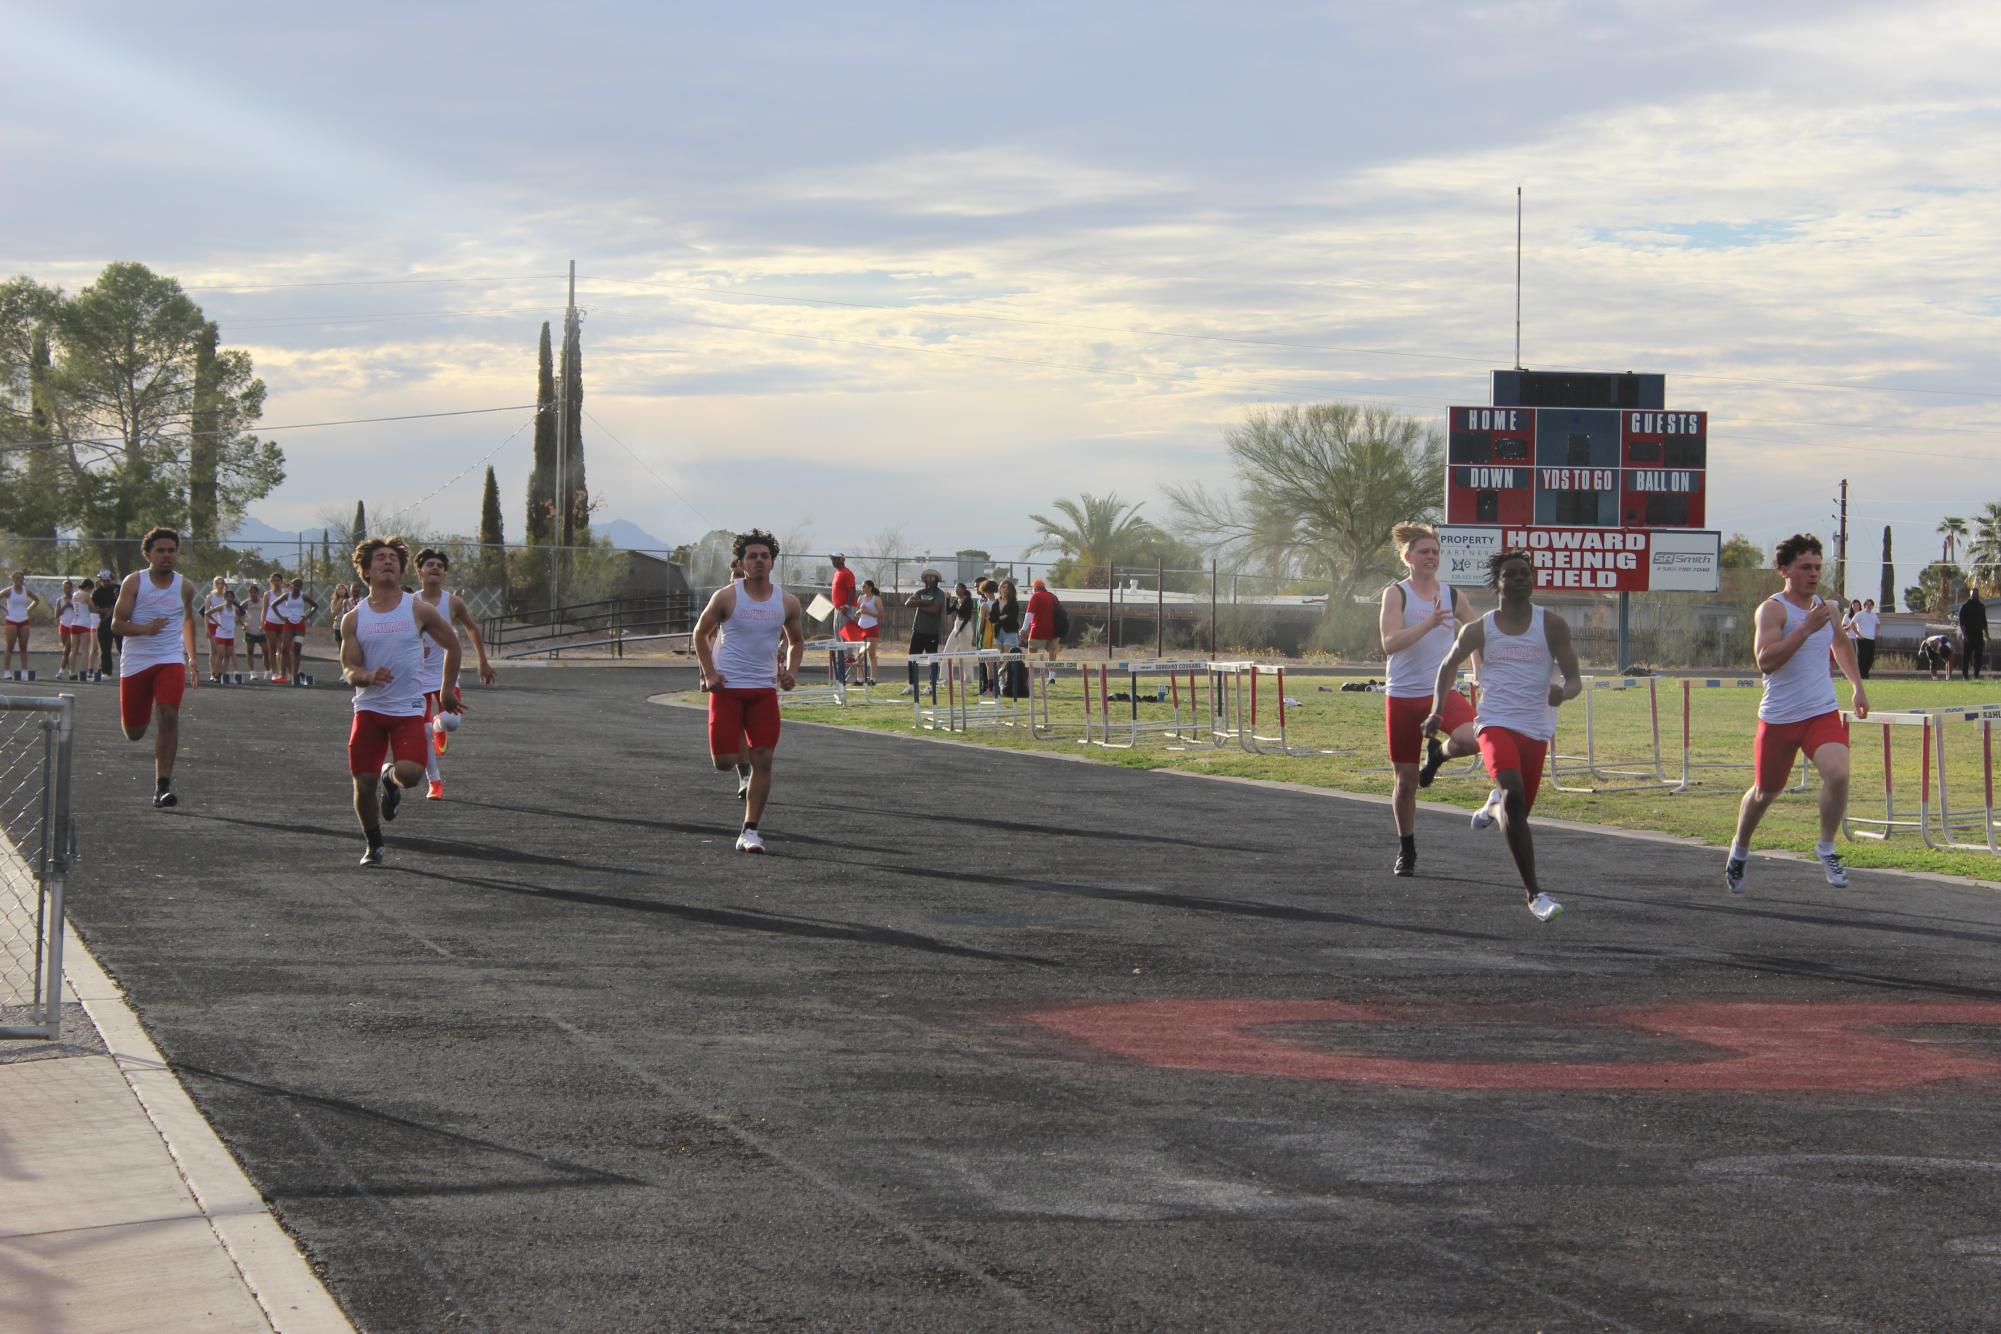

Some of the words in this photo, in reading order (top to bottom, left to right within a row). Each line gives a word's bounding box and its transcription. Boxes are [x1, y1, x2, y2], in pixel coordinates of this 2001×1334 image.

[1468, 410, 1517, 431] HOME
[1631, 413, 1699, 434] GUESTS
[1470, 467, 1514, 489] DOWN
[1542, 469, 1570, 490] YDS
[1573, 469, 1590, 490] TO
[1594, 470, 1613, 491] GO
[1636, 471, 1668, 492] BALL
[1671, 472, 1690, 492] ON
[1440, 535, 1495, 545] PROPERTY
[1506, 530, 1646, 551] HOWARD
[1522, 550, 1637, 570] REINIG
[1537, 569, 1617, 588] FIELD
